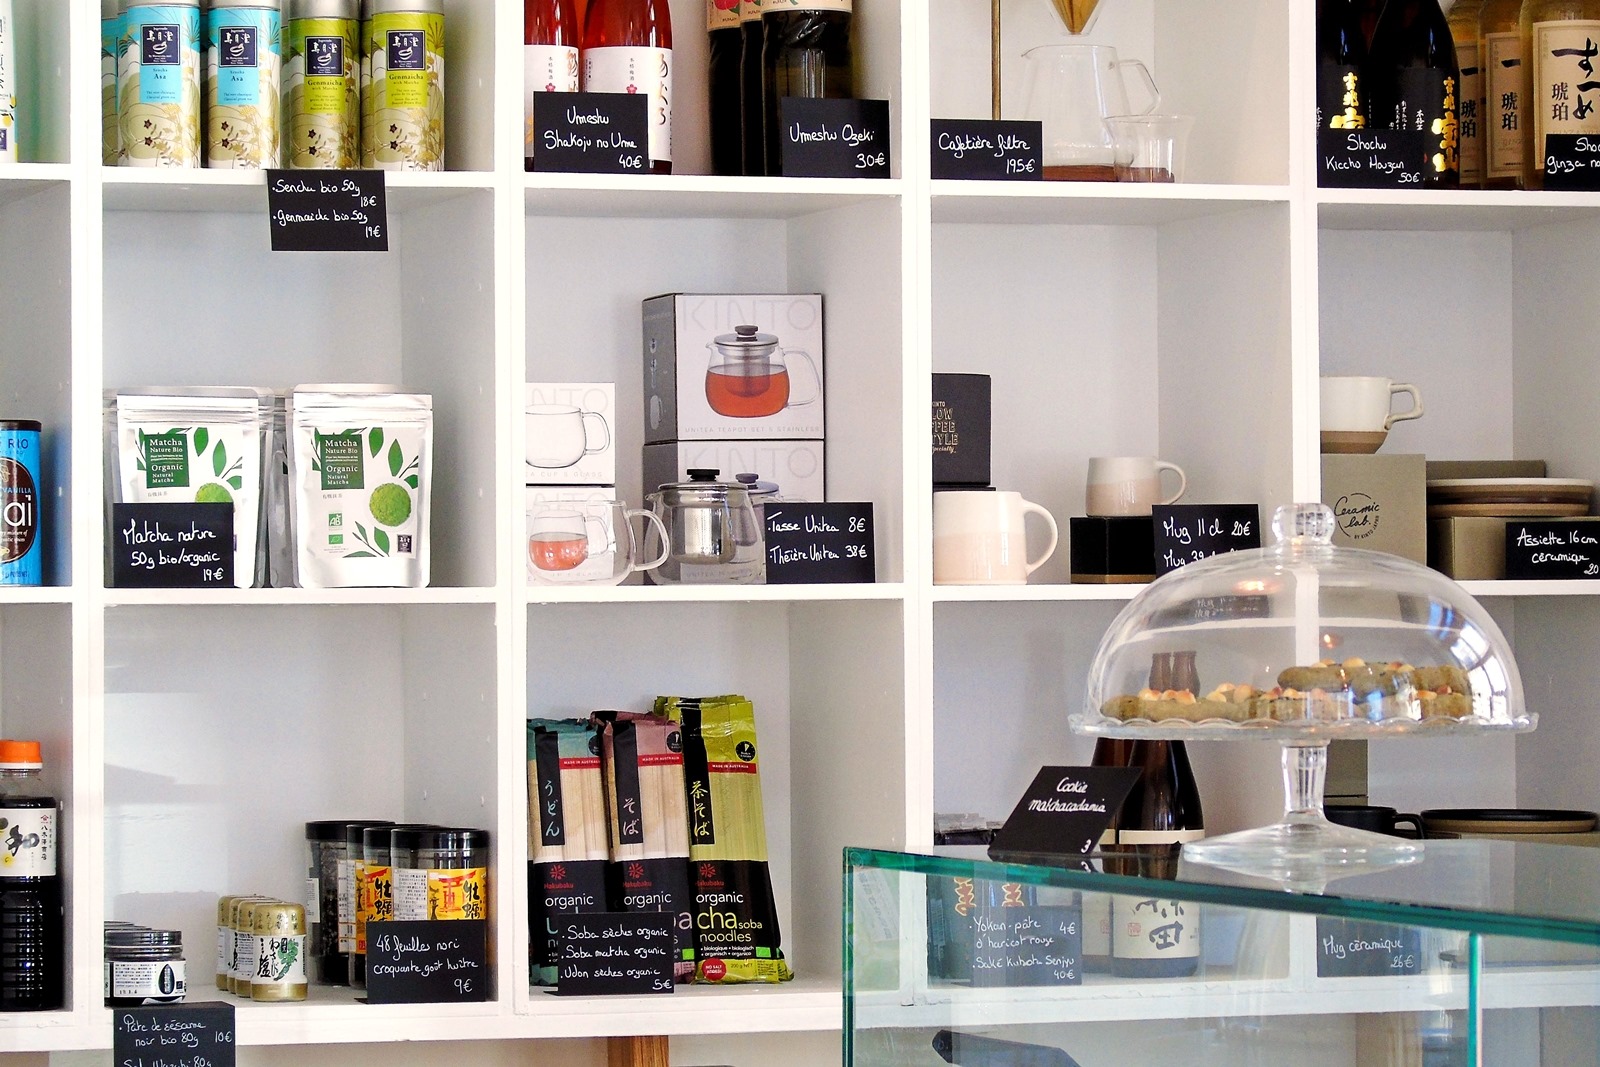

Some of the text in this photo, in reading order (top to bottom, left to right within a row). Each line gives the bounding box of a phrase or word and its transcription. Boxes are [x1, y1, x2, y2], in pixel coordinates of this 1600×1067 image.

[389, 73, 424, 81] Genmaicha
[1552, 82, 1569, 121] 琥珀
[566, 105, 609, 125] Umeshu
[1501, 92, 1518, 131] 琥珀
[596, 138, 609, 149] no
[610, 132, 637, 149] Ume
[789, 122, 875, 146] Umeshu Ozeki
[937, 132, 1030, 159] Cafetière filtre
[618, 154, 643, 169] 40€
[854, 152, 886, 169] 30€
[1005, 158, 1036, 174] 195€
[1398, 172, 1421, 183] 50€
[320, 180, 338, 193] bio
[341, 179, 360, 197] 50g
[360, 195, 377, 208] 18€
[333, 209, 349, 221] bio
[351, 210, 368, 224] 50g
[365, 226, 381, 238] 19€
[682, 299, 817, 331] KINTO
[7, 438, 29, 449] RIO
[150, 438, 183, 446] Matcha
[325, 438, 358, 447] Matcha
[151, 463, 184, 472] Organic
[326, 465, 358, 474] Organic
[1334, 495, 1380, 517] Ceramic
[122, 518, 173, 545] Matcha
[848, 517, 866, 533] 8€
[1163, 516, 1251, 545] Mug 20€
[1516, 527, 1566, 547] Assiette
[845, 544, 868, 559] 38€
[131, 551, 156, 569] 50g
[203, 568, 224, 582] 19€
[1056, 776, 1089, 794] Cookie
[544, 779, 560, 837] うどん
[690, 780, 710, 837] 茶そば
[622, 797, 640, 836] そば
[545, 892, 594, 910] organic
[624, 890, 672, 909] organic
[695, 891, 744, 907] organic
[696, 906, 738, 930] cha
[738, 918, 763, 930] soba
[567, 925, 599, 940] Soba
[637, 927, 669, 940] organic
[699, 929, 752, 943] noodles
[1059, 921, 1077, 935] 4€
[376, 934, 391, 953] 48
[436, 938, 460, 951] nori
[1322, 935, 1346, 959] Mug
[565, 945, 593, 959] Soba
[634, 946, 666, 959] organic
[1390, 956, 1415, 968] 26€
[626, 967, 661, 979] organic
[1053, 970, 1075, 980] 40€
[453, 978, 473, 994] 9€
[652, 979, 672, 991] 5€
[151, 1016, 161, 1031] de
[135, 1031, 233, 1048] noir bio 80g 10€
